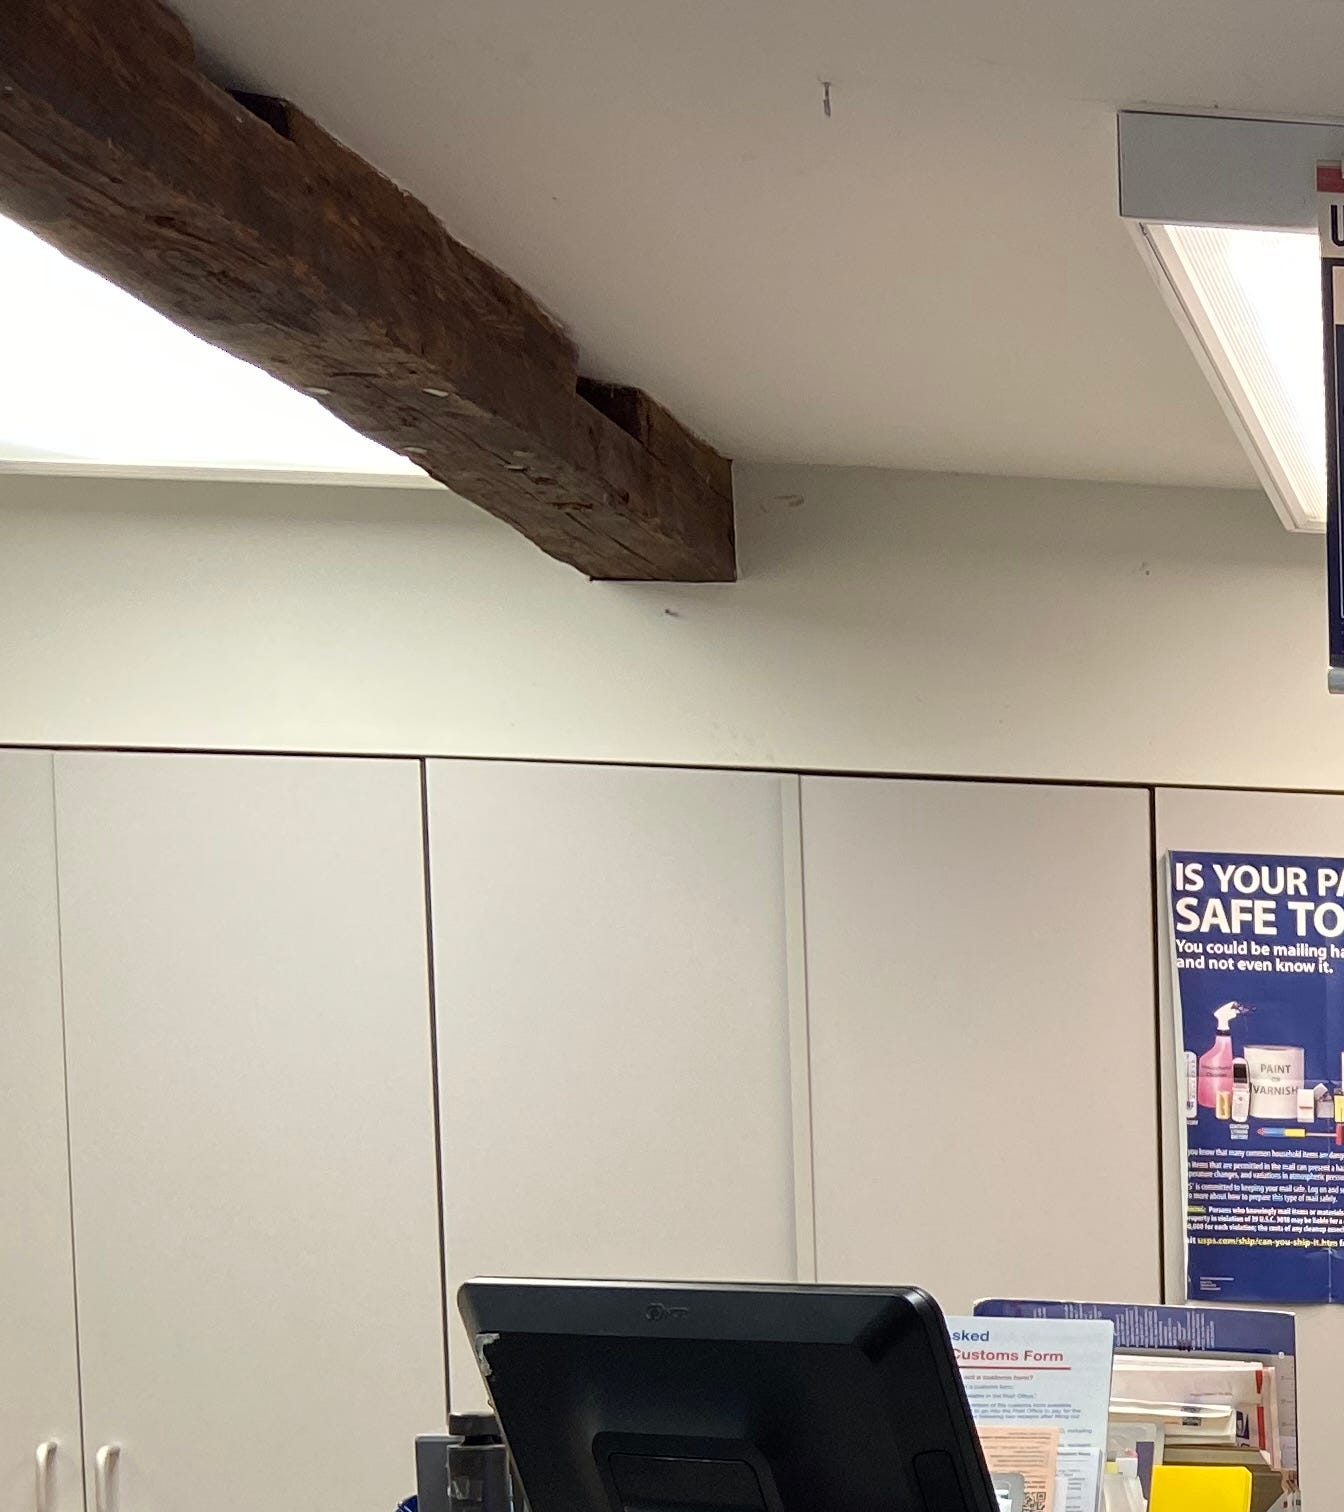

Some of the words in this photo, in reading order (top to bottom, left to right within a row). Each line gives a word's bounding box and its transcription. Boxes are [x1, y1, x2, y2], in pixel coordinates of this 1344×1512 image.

[1176, 862, 1204, 892] IS
[1212, 864, 1308, 896] YOUR
[1175, 897, 1278, 935] SAFE
[1176, 940, 1204, 954] You
[1206, 941, 1247, 955] could
[1251, 942, 1270, 956] be
[1273, 944, 1327, 960] mailing
[1176, 956, 1205, 968] and
[1208, 958, 1234, 970] not
[1238, 960, 1272, 972] even
[1276, 960, 1316, 973] know
[1318, 961, 1334, 974] it.
[1260, 1064, 1291, 1074] PAINT
[1252, 1085, 1298, 1096] VARNISH
[952, 1330, 990, 1342] sked
[1024, 1350, 1064, 1362] Form
